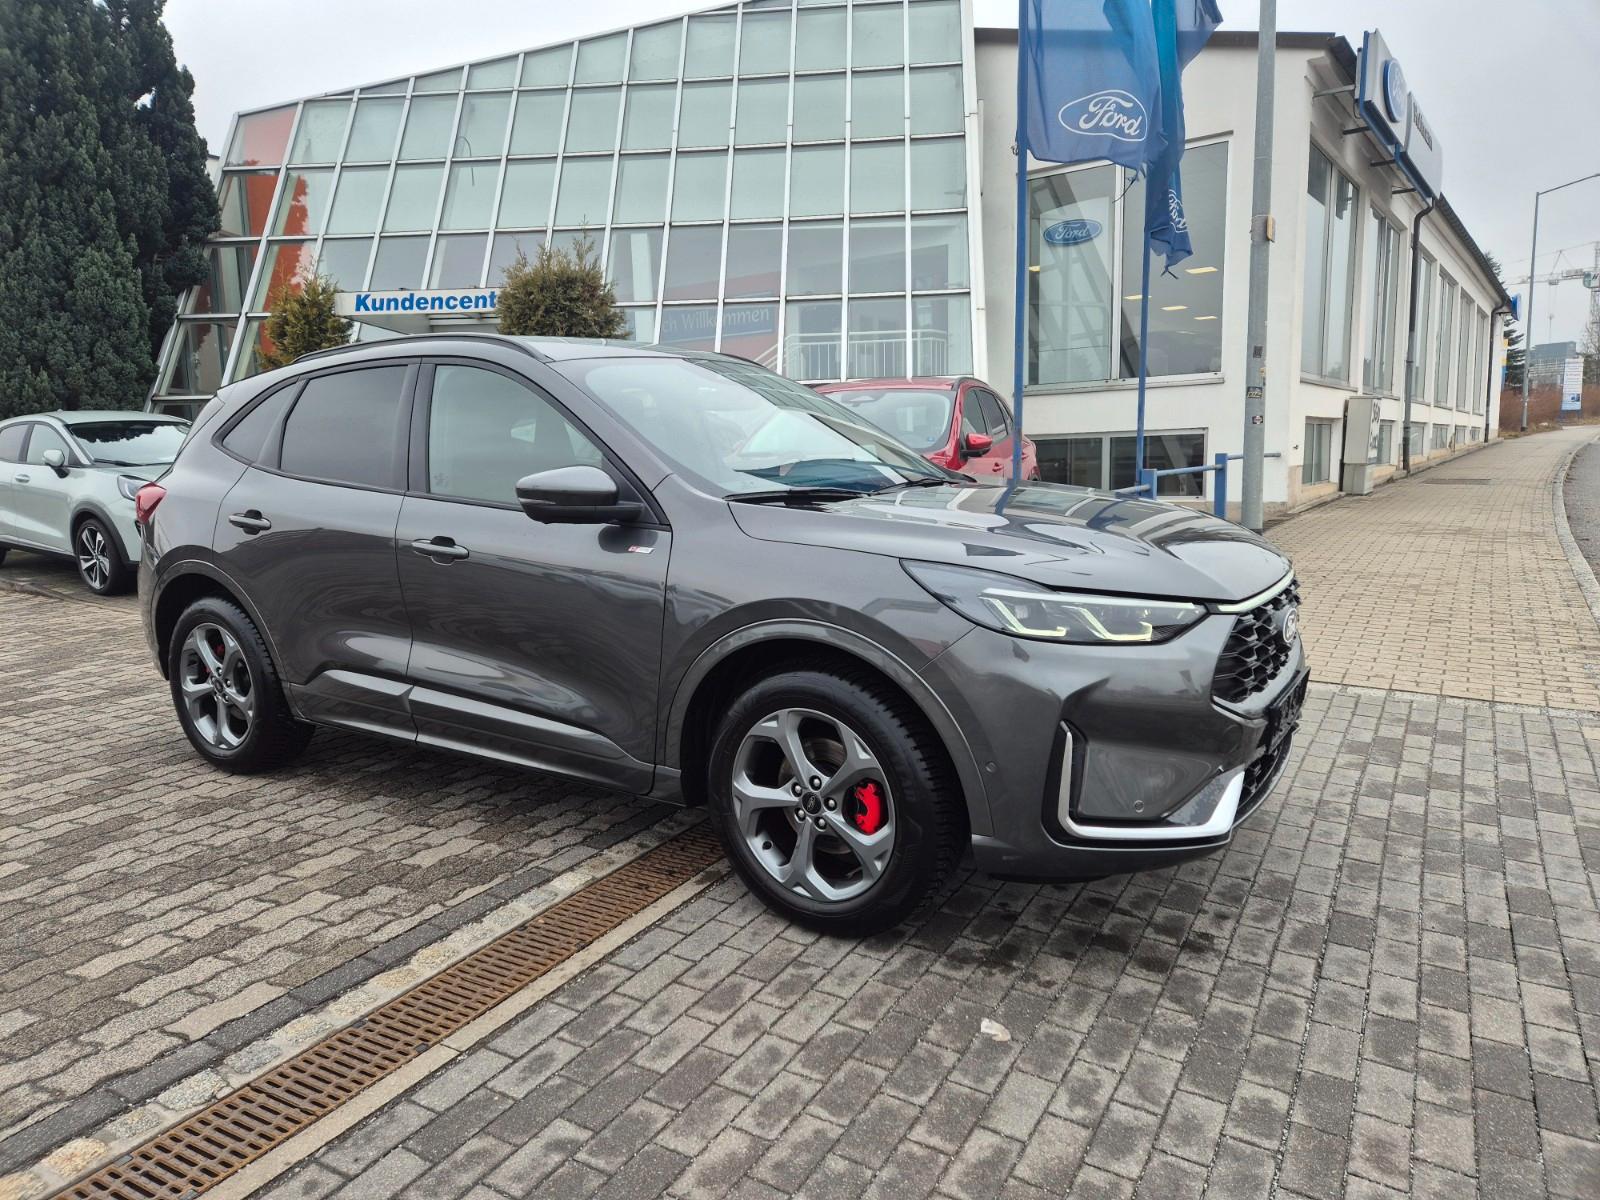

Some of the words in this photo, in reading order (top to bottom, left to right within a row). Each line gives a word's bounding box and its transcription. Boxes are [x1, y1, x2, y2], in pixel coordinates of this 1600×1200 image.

[1079, 96, 1142, 135] Ford
[1055, 223, 1090, 240] Ford
[681, 308, 769, 329] Willkmmen
